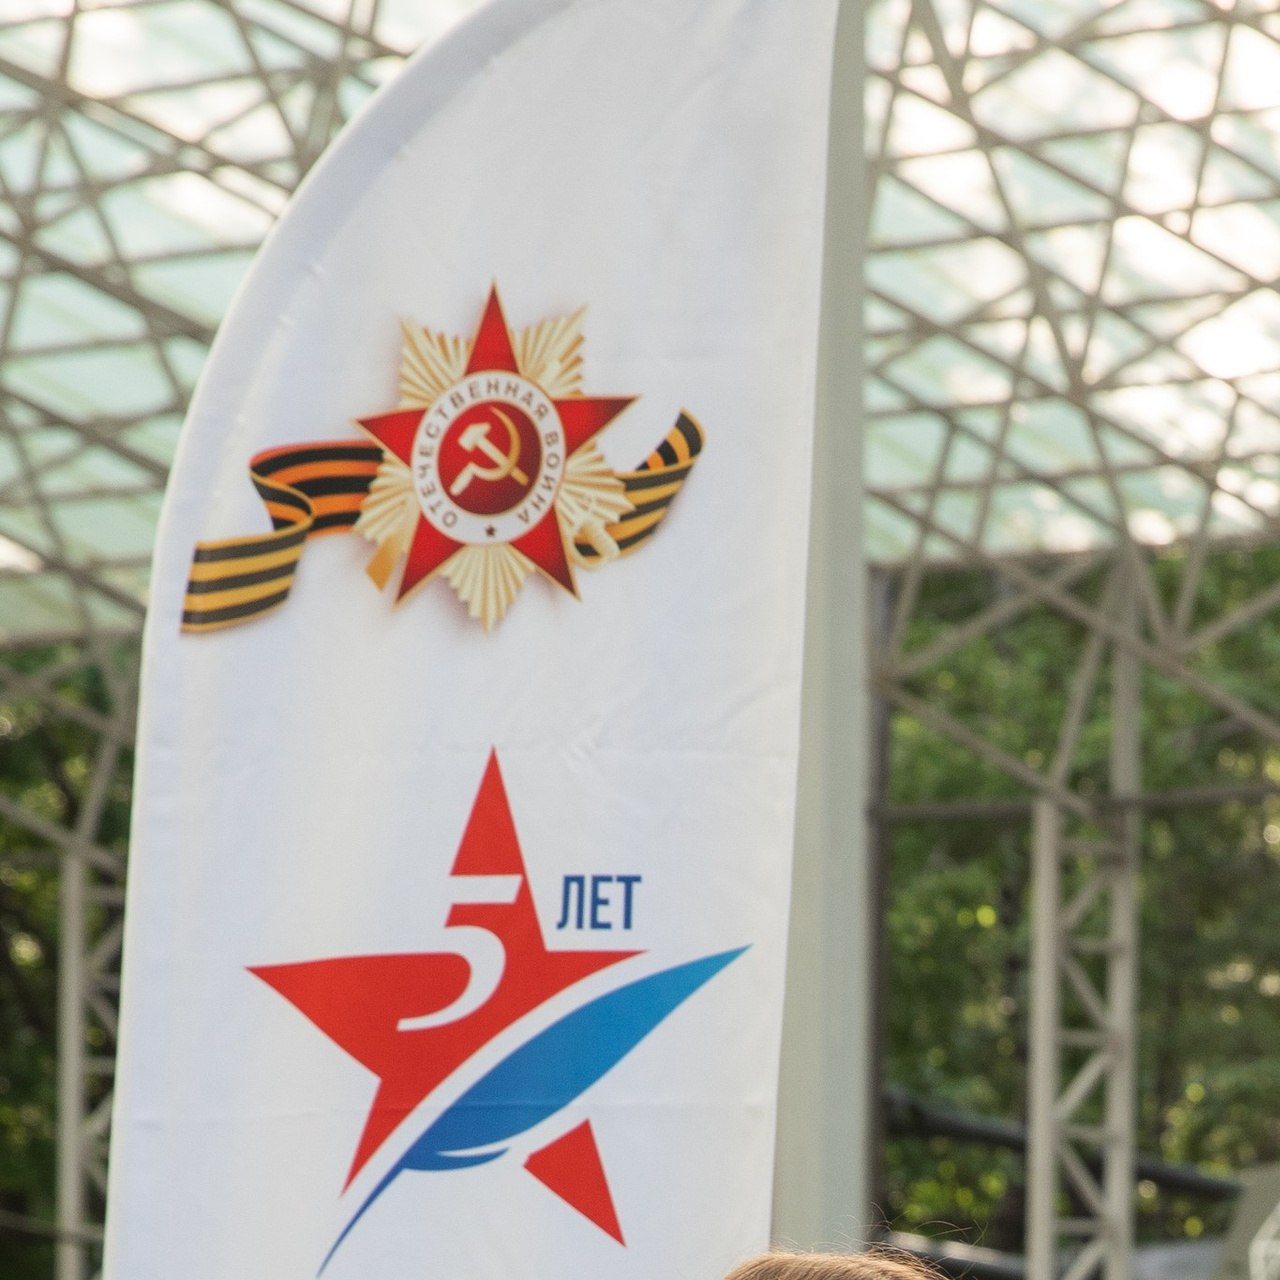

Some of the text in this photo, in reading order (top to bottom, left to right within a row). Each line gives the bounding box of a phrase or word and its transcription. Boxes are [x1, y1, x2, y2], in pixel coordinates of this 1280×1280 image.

[418, 379, 549, 528] ОТЕЧЕСТВЕННАЯ
[395, 874, 643, 1031] 5 ЛЕТ
